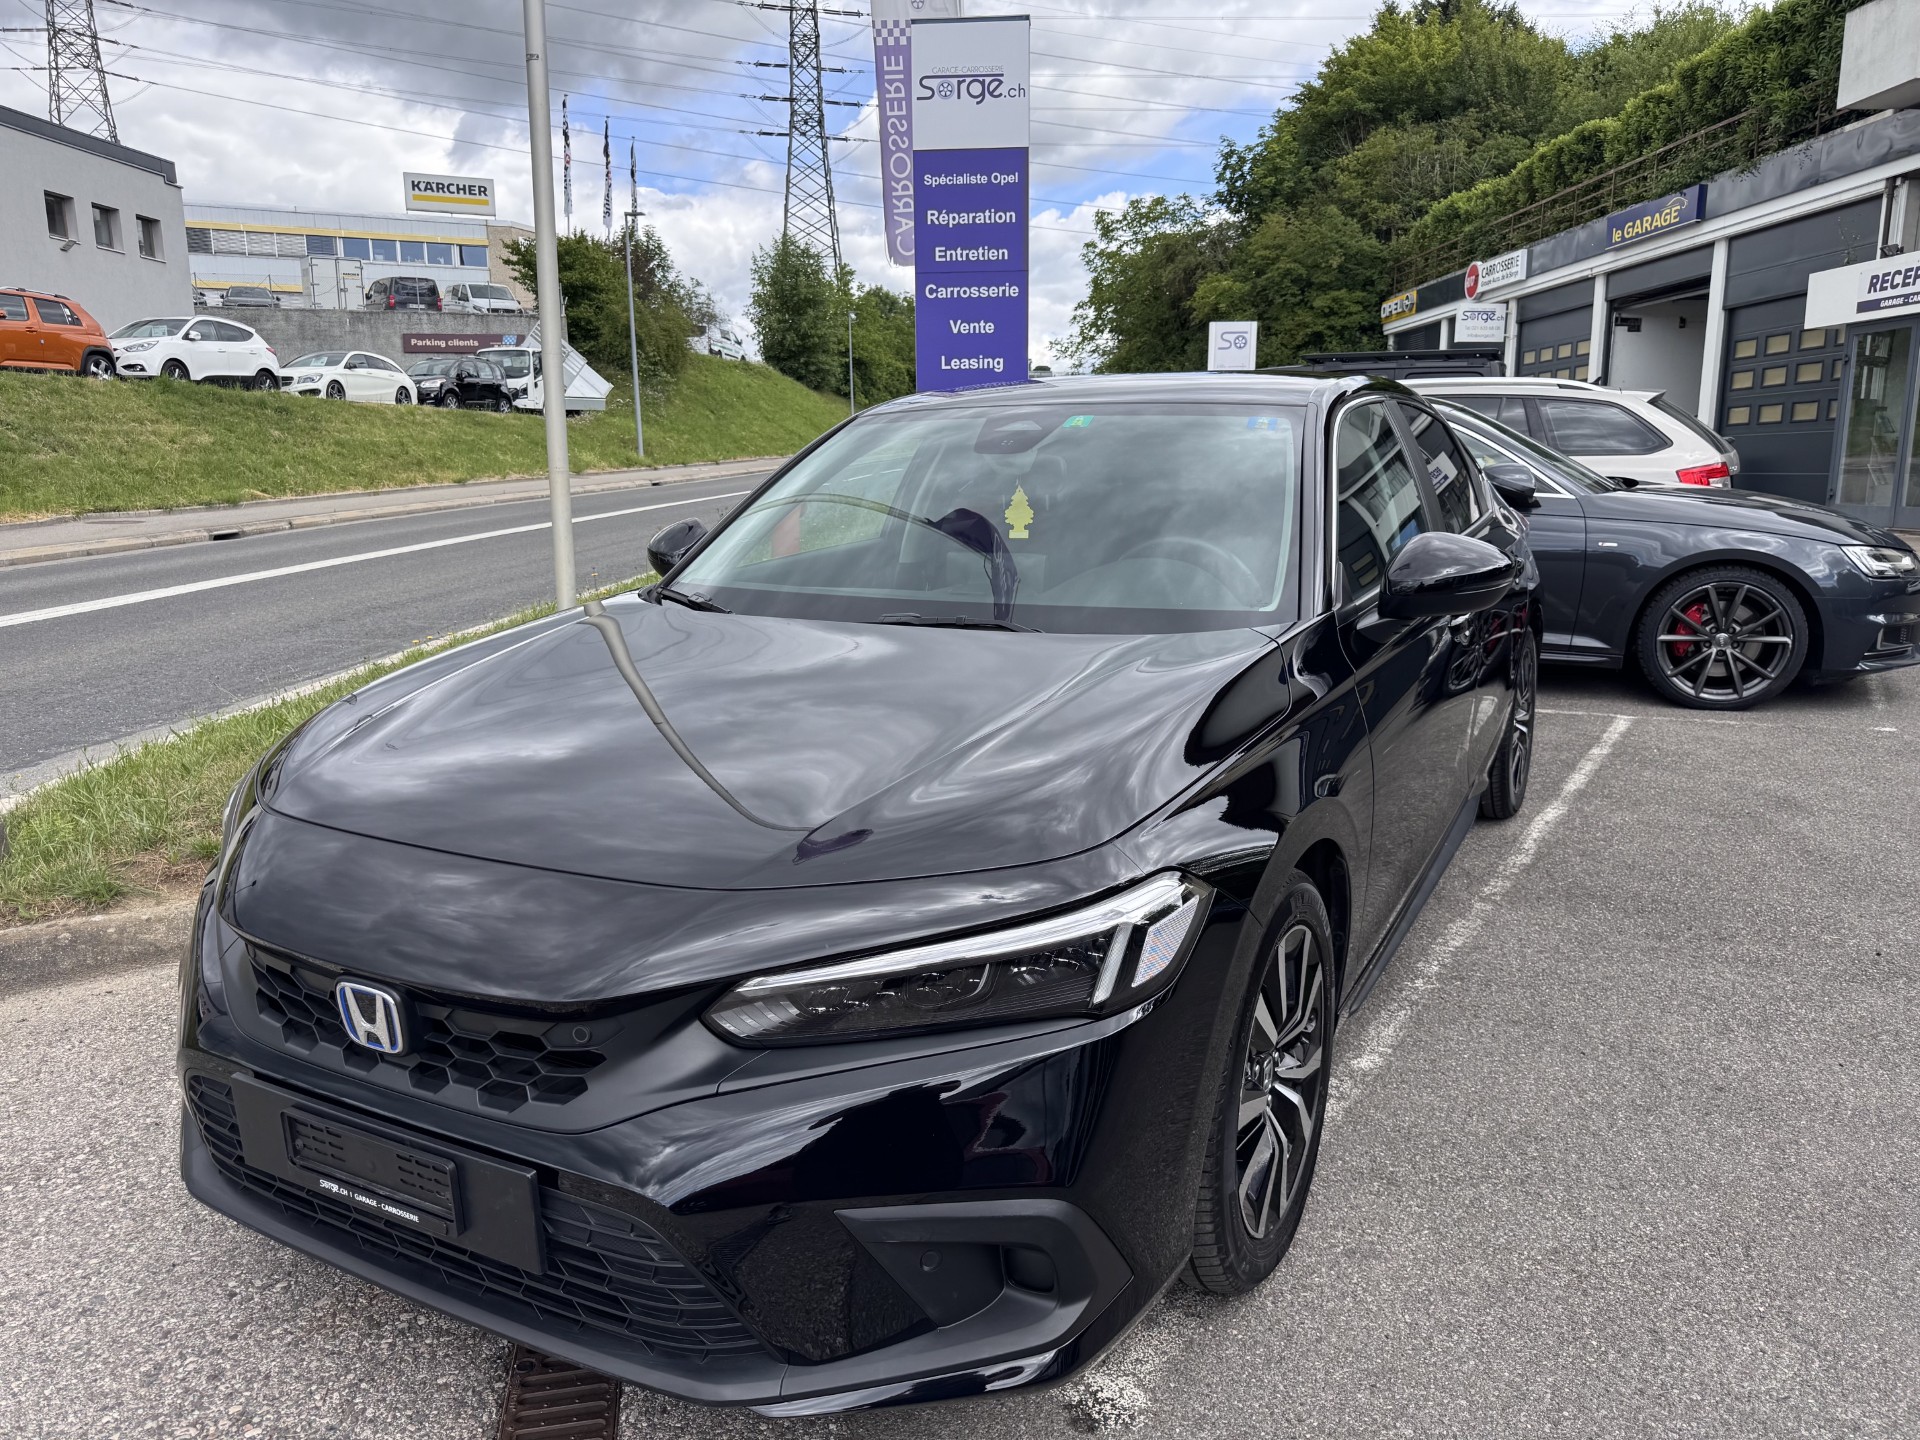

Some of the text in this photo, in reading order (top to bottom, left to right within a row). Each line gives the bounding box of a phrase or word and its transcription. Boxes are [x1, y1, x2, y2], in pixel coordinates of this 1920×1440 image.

[923, 171, 1019, 187] Spécialiste Opel
[411, 180, 489, 197] KÄRCHER
[926, 208, 1017, 228] Réparation
[1612, 205, 1681, 243] le GARAGE
[934, 246, 1009, 263] Entretien
[1481, 255, 1520, 278] CARROSSERIE
[925, 282, 1019, 299] Carrosserie
[1380, 299, 1404, 319] OPEL
[1880, 297, 1904, 307] GARAGE
[1461, 311, 1504, 323] Sorge.ch
[949, 319, 995, 334] Vente
[411, 338, 446, 348] Parking
[448, 338, 479, 347] clients
[940, 355, 1004, 373] Leasing
[354, 1193, 378, 1208] GARAGE
[381, 1203, 420, 1223] CARROSSERIE
